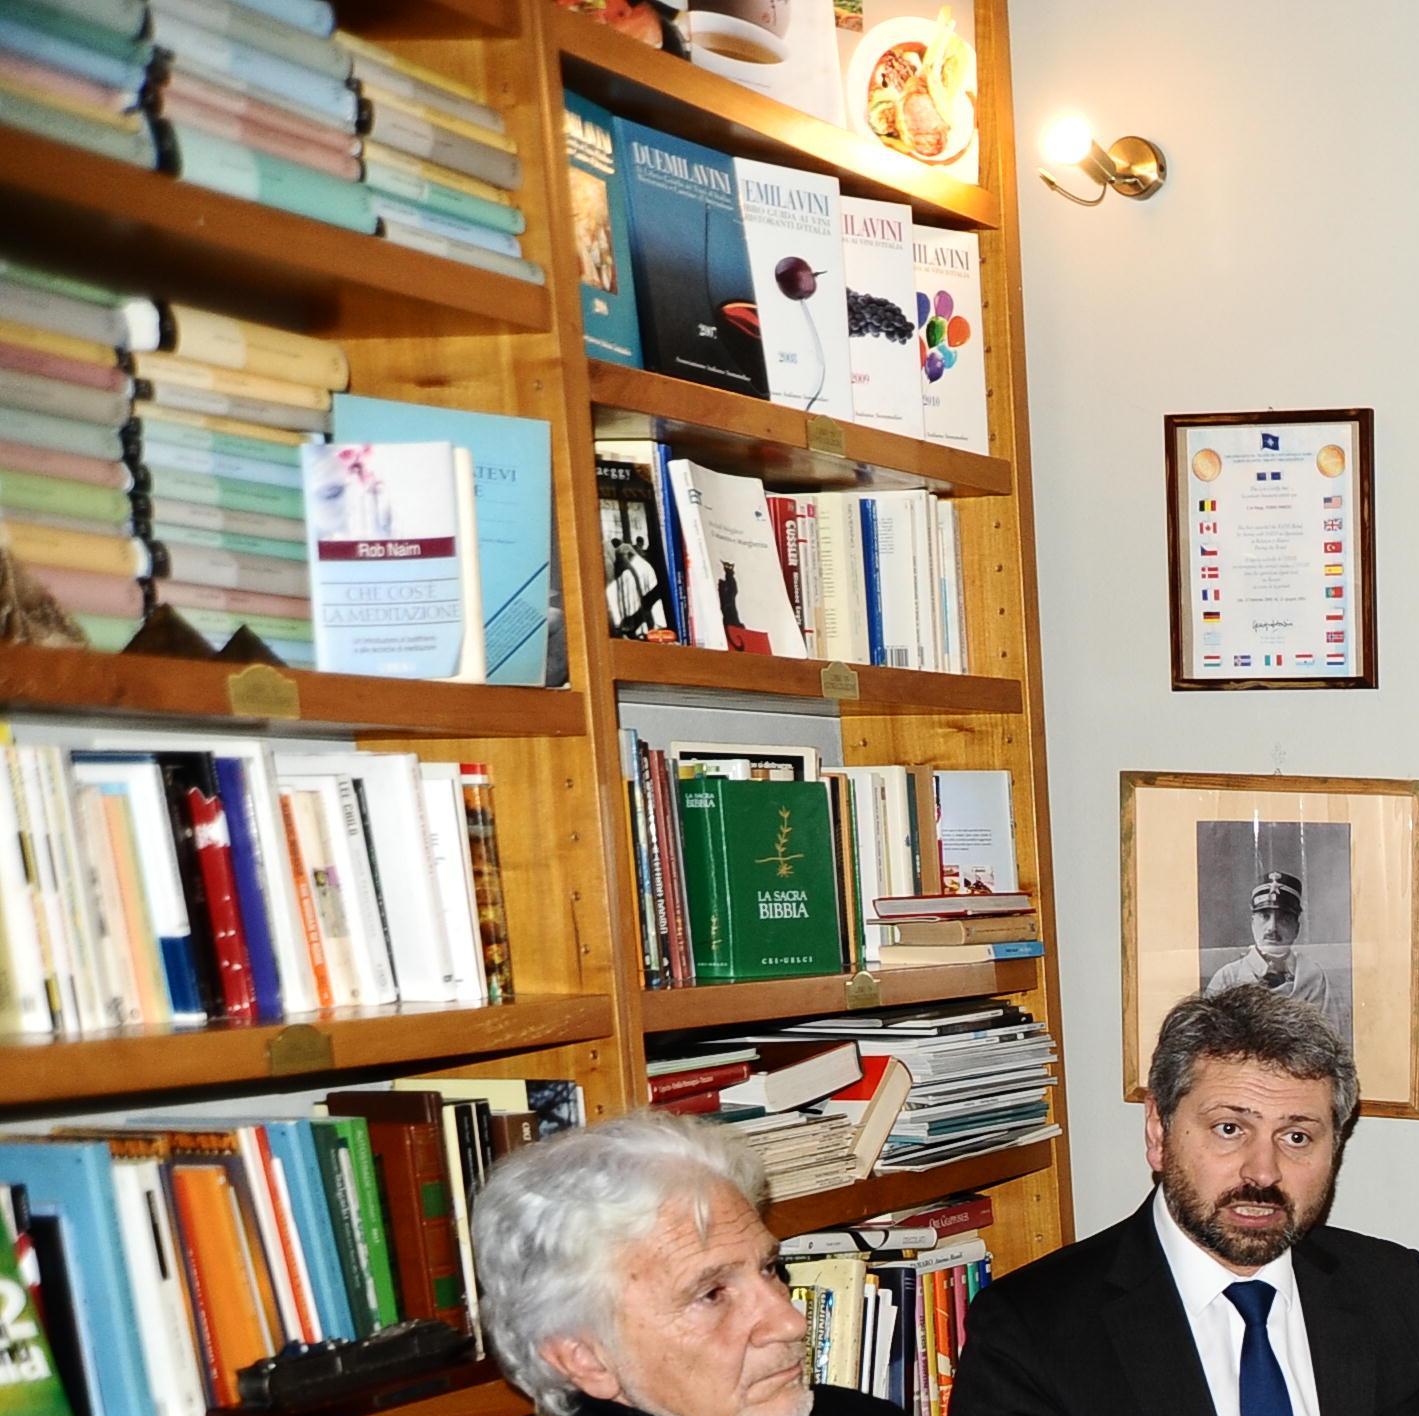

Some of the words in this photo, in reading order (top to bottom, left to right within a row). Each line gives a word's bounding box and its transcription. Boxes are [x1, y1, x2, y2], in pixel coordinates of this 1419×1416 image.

[632, 141, 732, 195] DUEMILAVINI
[741, 179, 829, 217] EMILAVINI
[841, 213, 903, 243] ILAVINI
[850, 374, 870, 386] 2009
[358, 543, 384, 558] Rob
[785, 520, 797, 566] CUSSLER
[346, 586, 382, 601] CHE
[323, 607, 345, 623] LA
[350, 603, 460, 623] MEDITAZIONE
[338, 780, 350, 801] LEE
[686, 799, 716, 808] BIBBIA
[758, 891, 771, 901] LA
[773, 890, 808, 901] SACRA
[759, 903, 809, 919] BIBBIA
